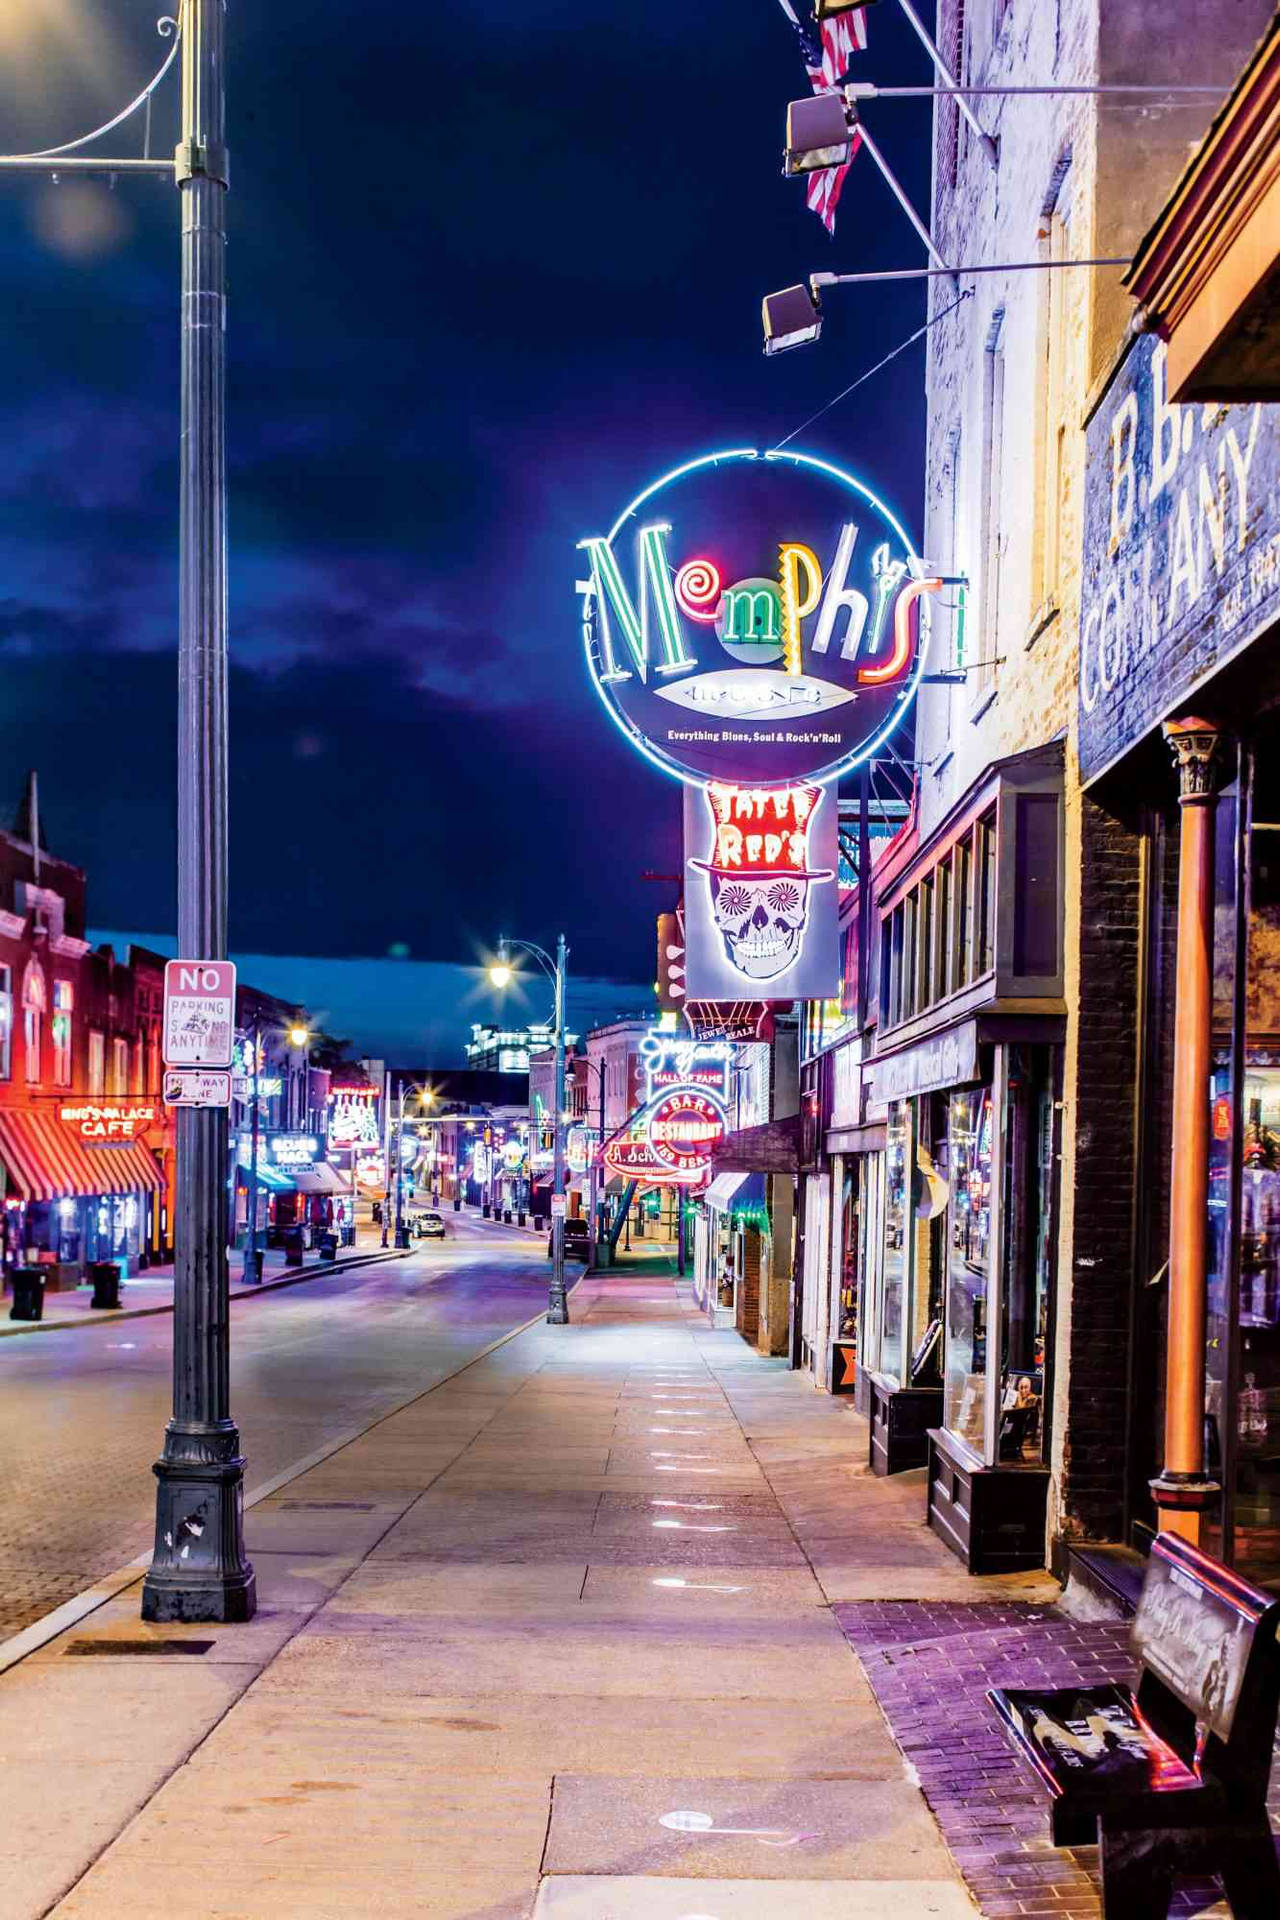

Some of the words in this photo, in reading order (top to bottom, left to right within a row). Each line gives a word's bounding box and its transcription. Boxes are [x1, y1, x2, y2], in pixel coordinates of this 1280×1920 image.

[668, 730, 719, 742] Everything
[722, 731, 751, 743] Blues,
[754, 731, 775, 742] Soul
[776, 732, 785, 742] &
[786, 731, 841, 743] Rock'n'Roll
[179, 968, 221, 991] NO
[171, 1000, 224, 1015] PARKING
[170, 1034, 228, 1050] ANYTIME
[654, 1074, 679, 1084] HALL
[696, 1074, 722, 1084] FAME
[669, 1094, 706, 1112] BAR
[81, 1121, 134, 1136] CAFE
[678, 1156, 705, 1168] BEA
